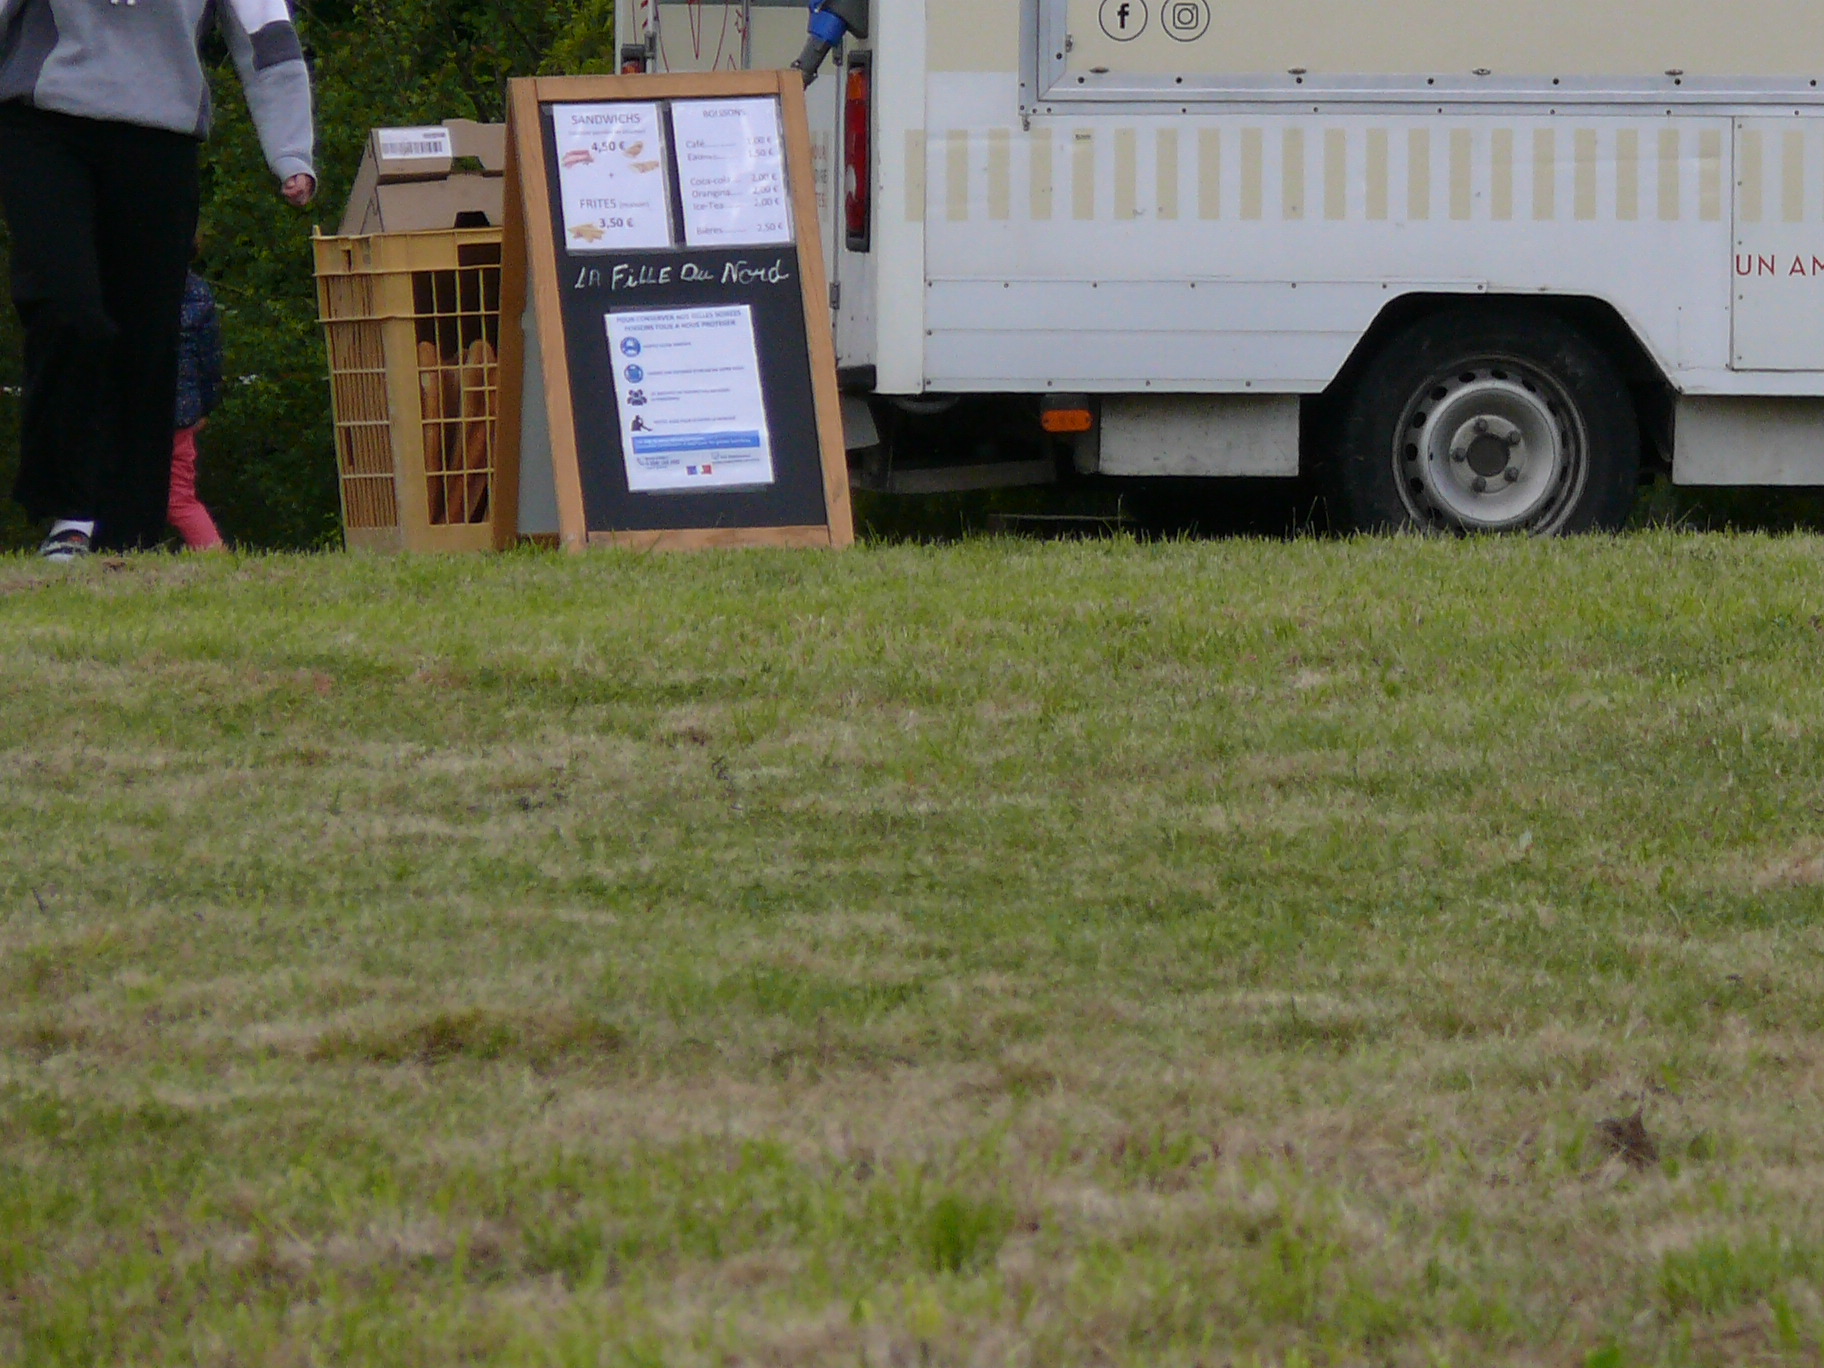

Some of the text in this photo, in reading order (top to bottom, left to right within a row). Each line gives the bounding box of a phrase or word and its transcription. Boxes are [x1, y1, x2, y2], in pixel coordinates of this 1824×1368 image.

[571, 113, 641, 125] SANDWICHS
[591, 141, 616, 152] 4,50
[580, 199, 616, 209] FRITES
[599, 218, 623, 229] 3,50
[1735, 254, 1776, 276] UN
[574, 267, 600, 289] LA
[721, 259, 789, 284] Nord
